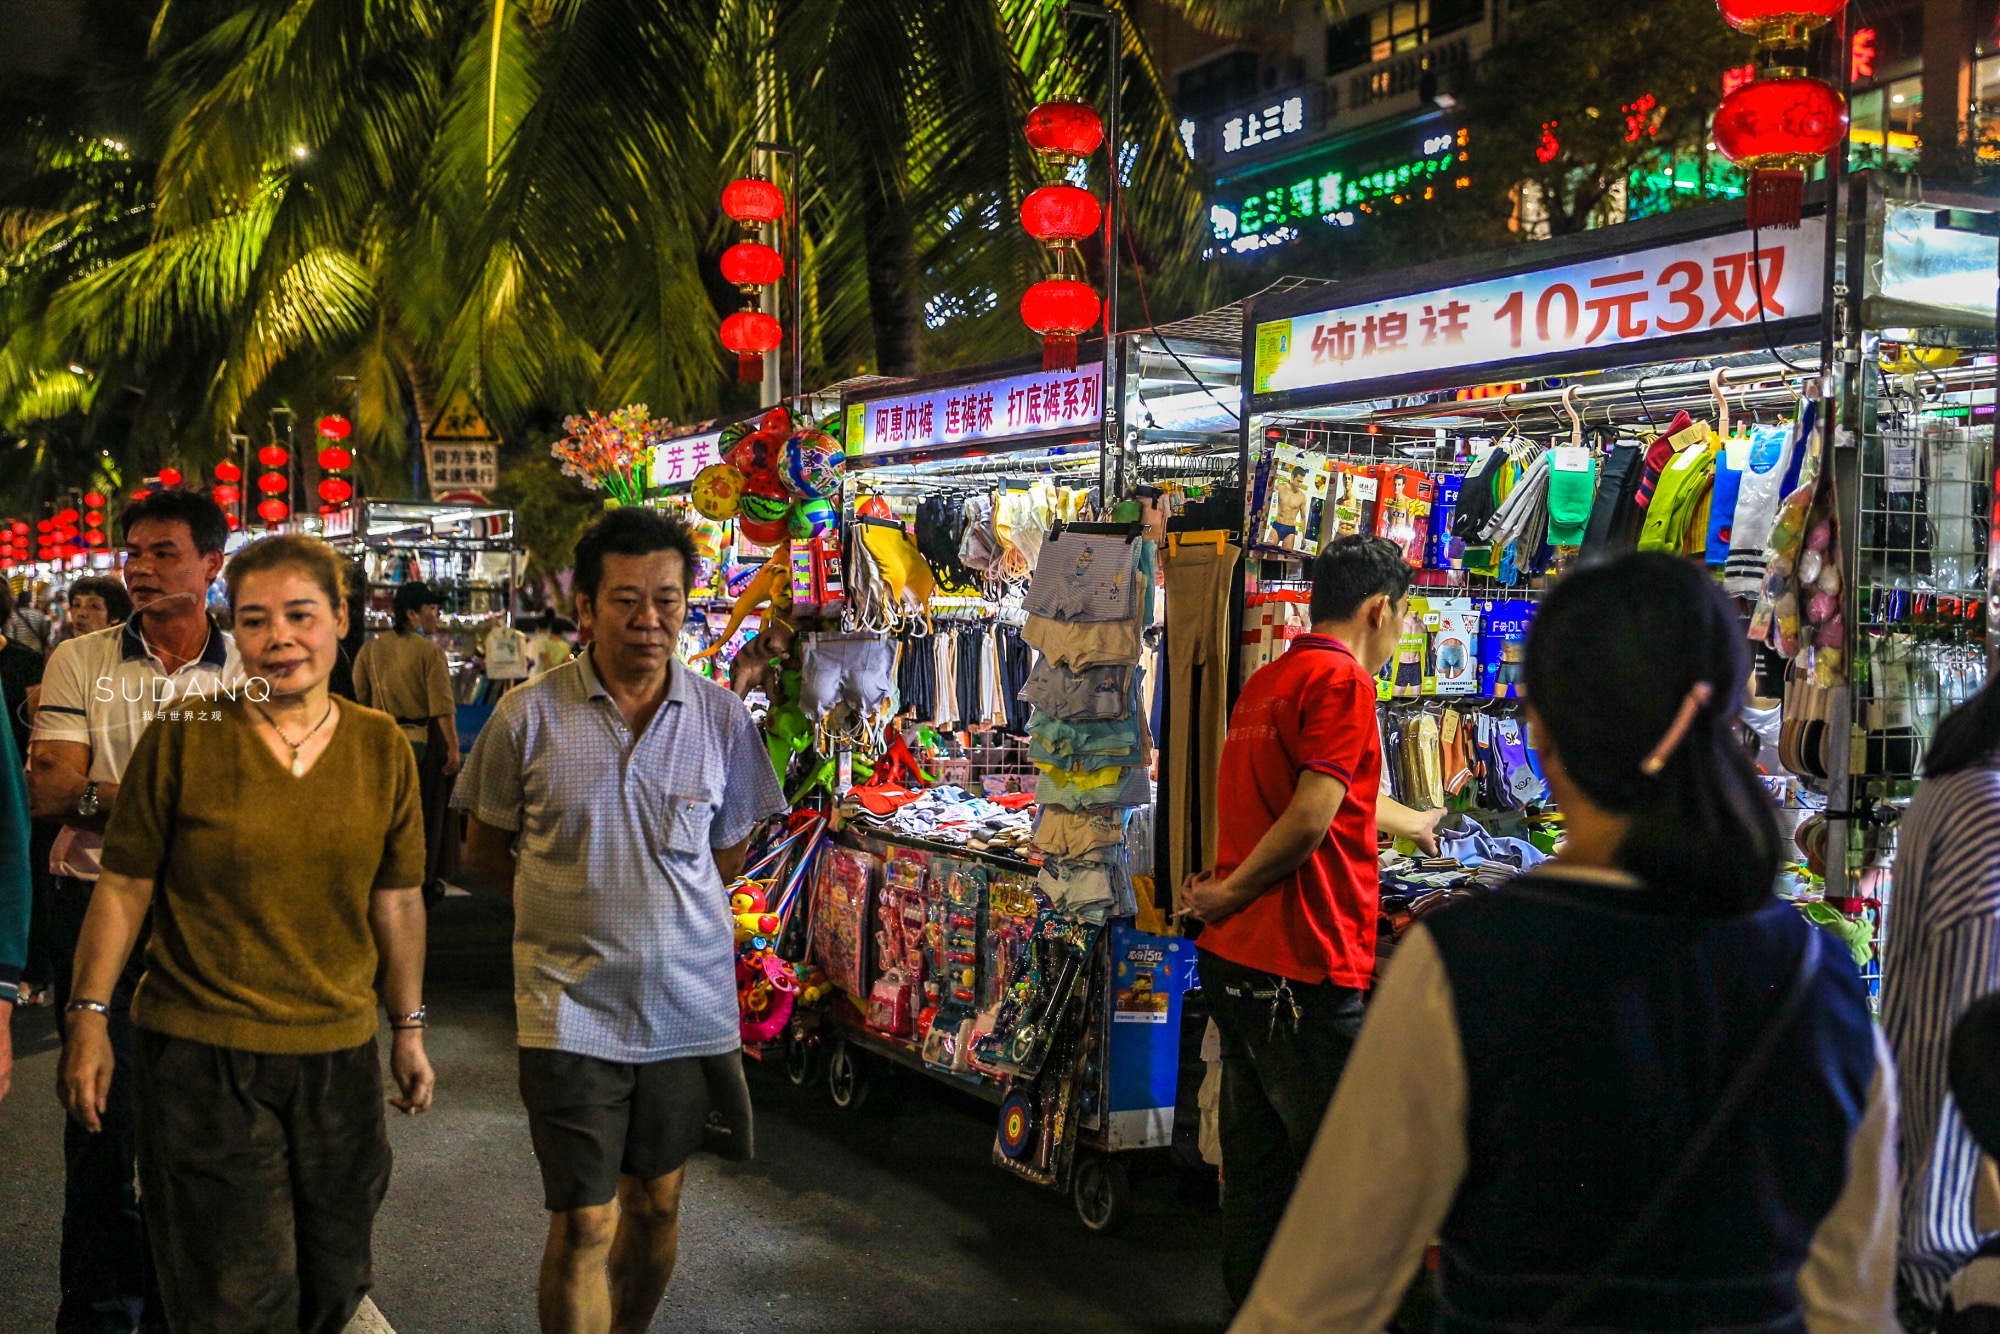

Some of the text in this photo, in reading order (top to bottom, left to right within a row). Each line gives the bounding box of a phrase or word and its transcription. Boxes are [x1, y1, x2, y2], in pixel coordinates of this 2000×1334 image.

[1494, 246, 1785, 349] 10元3双
[875, 400, 934, 443] 阿惠内裤
[945, 390, 994, 435] 连裤袜
[1007, 373, 1100, 428] 打底裤系列
[667, 440, 723, 480] 芳芳
[1408, 497, 1426, 518] 红
